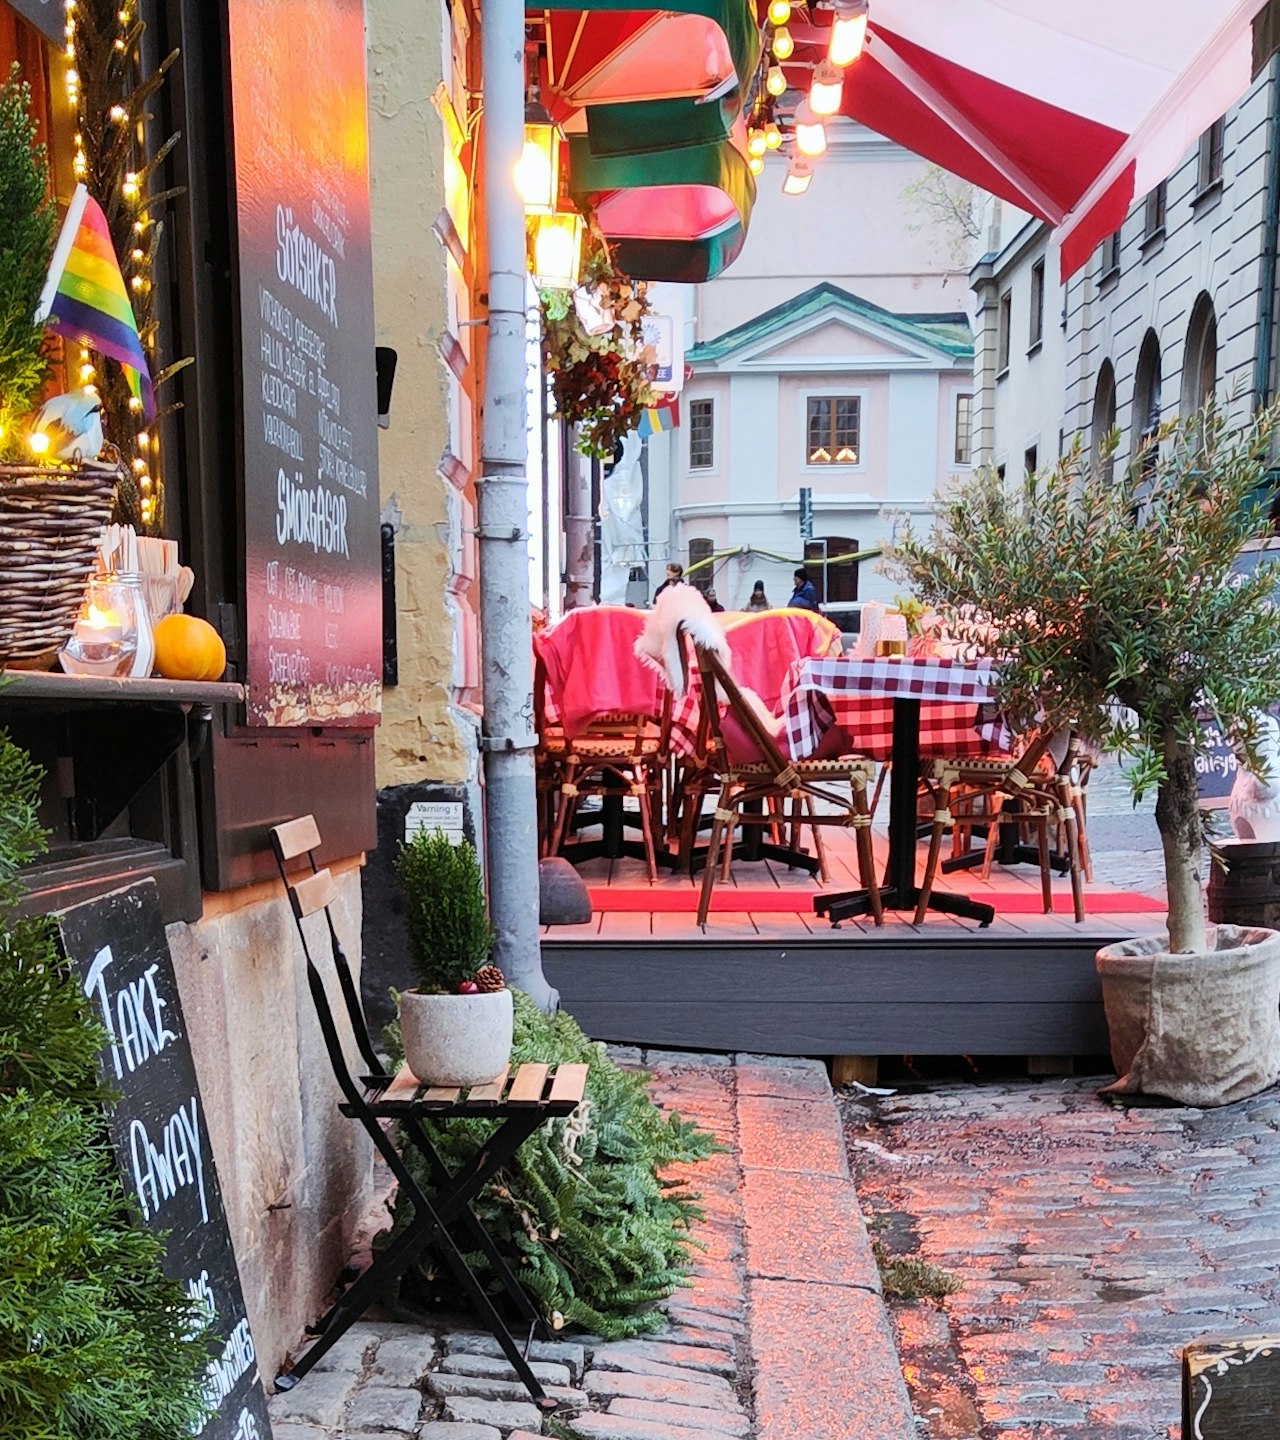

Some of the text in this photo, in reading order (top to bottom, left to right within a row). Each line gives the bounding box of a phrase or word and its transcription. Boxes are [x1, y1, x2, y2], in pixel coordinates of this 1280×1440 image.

[276, 202, 339, 330] SÖTSAKER
[276, 467, 350, 561] SMÖRGÅSAR
[417, 804, 451, 814] Varning
[84, 944, 178, 1080] TAKE
[130, 1096, 209, 1225] AWAY
